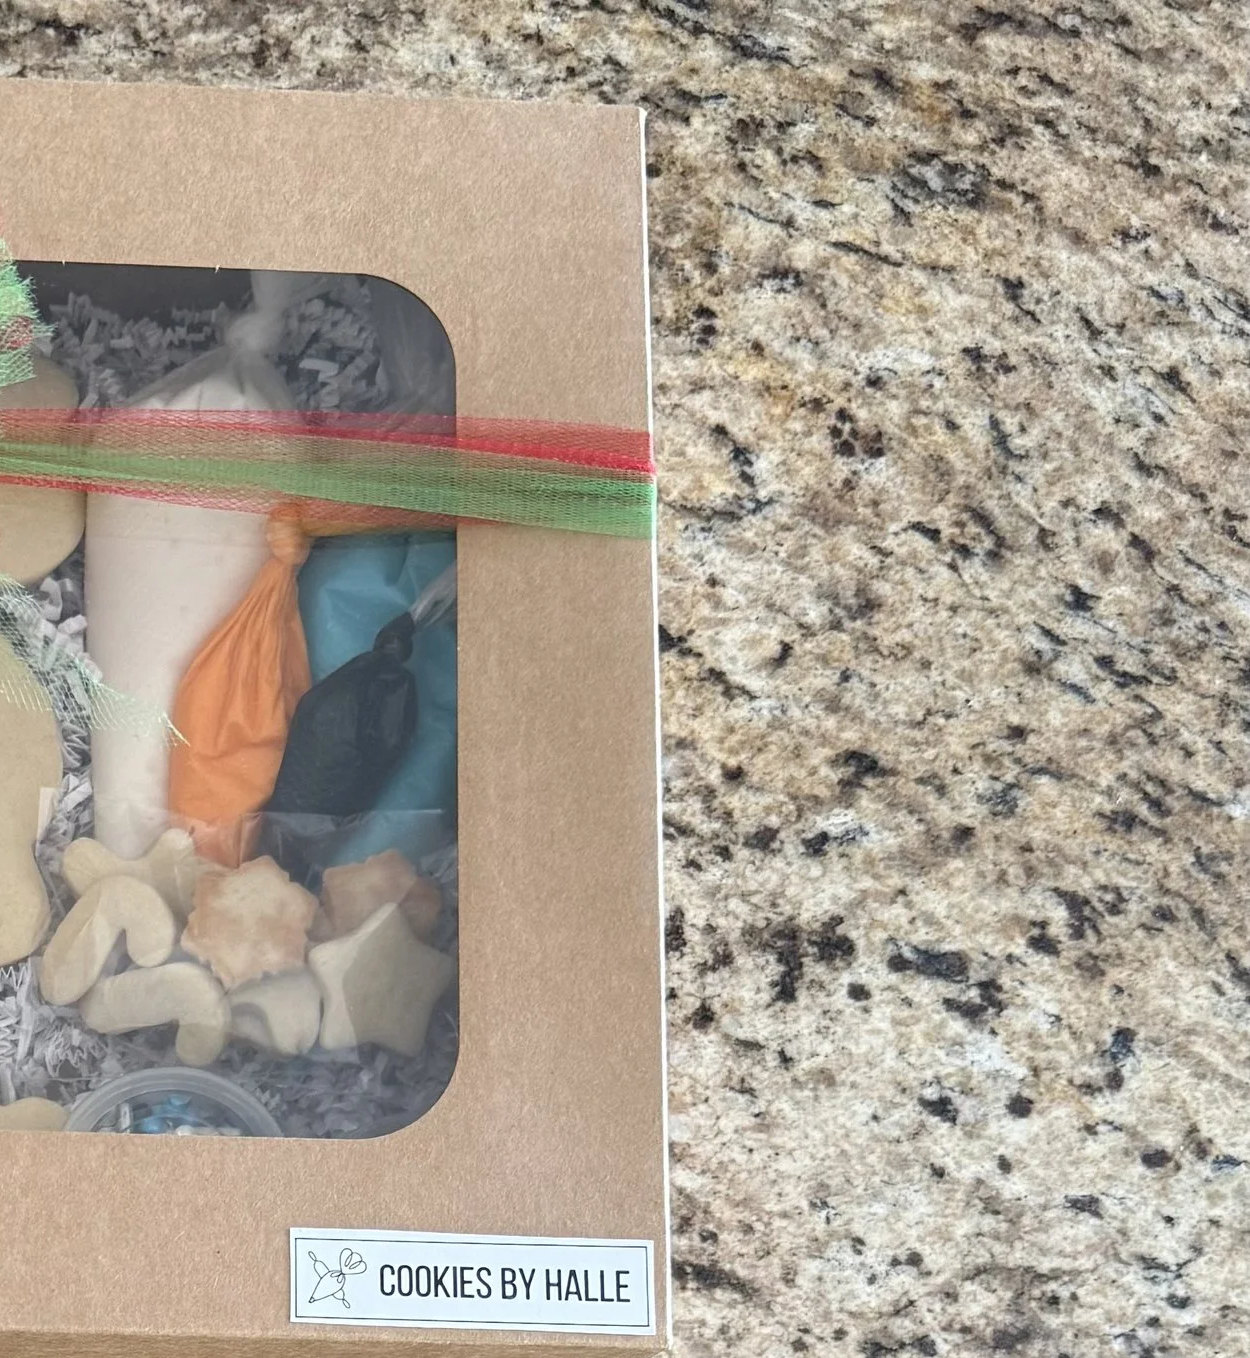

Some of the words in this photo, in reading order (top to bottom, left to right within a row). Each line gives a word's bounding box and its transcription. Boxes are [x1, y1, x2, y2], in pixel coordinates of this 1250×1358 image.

[379, 1263, 492, 1299] COOKIES
[501, 1266, 536, 1300] BY
[545, 1268, 631, 1303] HALLE
